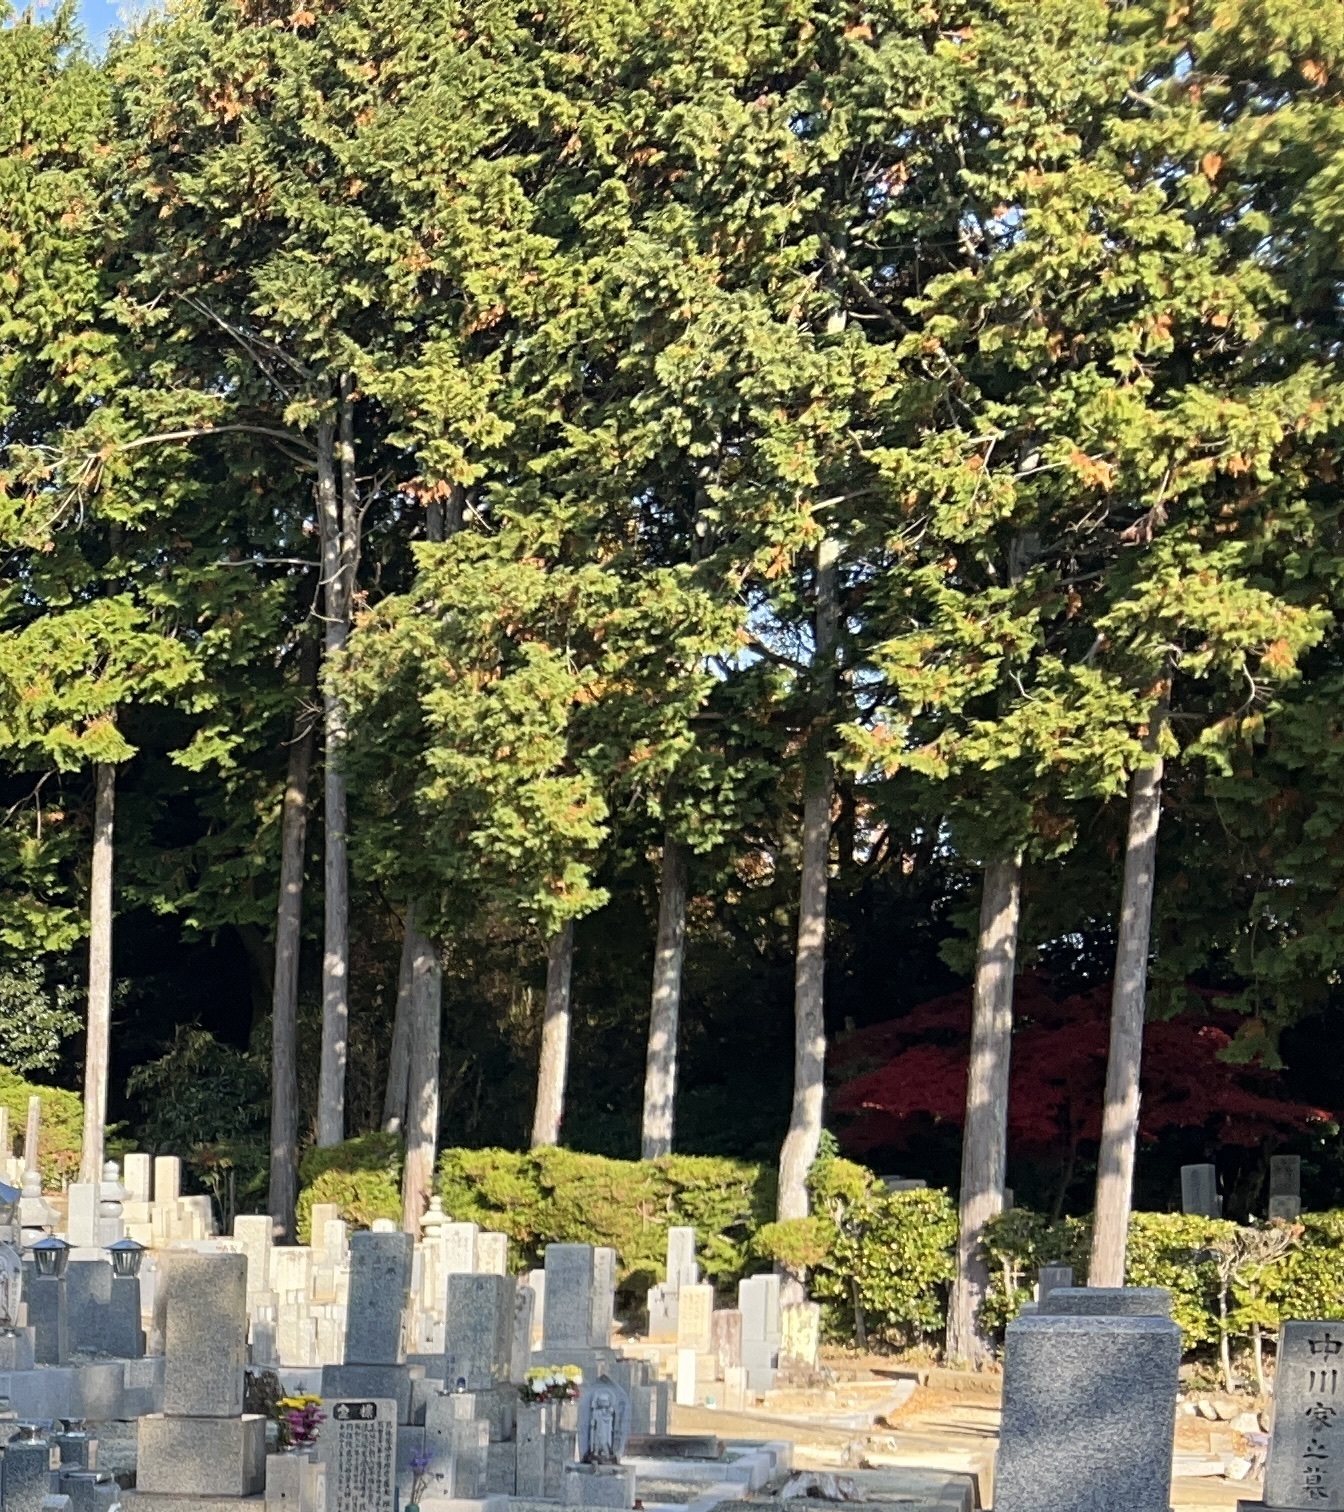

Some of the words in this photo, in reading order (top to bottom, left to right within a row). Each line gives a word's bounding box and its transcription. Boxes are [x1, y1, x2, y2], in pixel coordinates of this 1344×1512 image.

[1302, 1332, 1344, 1499] 中川家之墓
